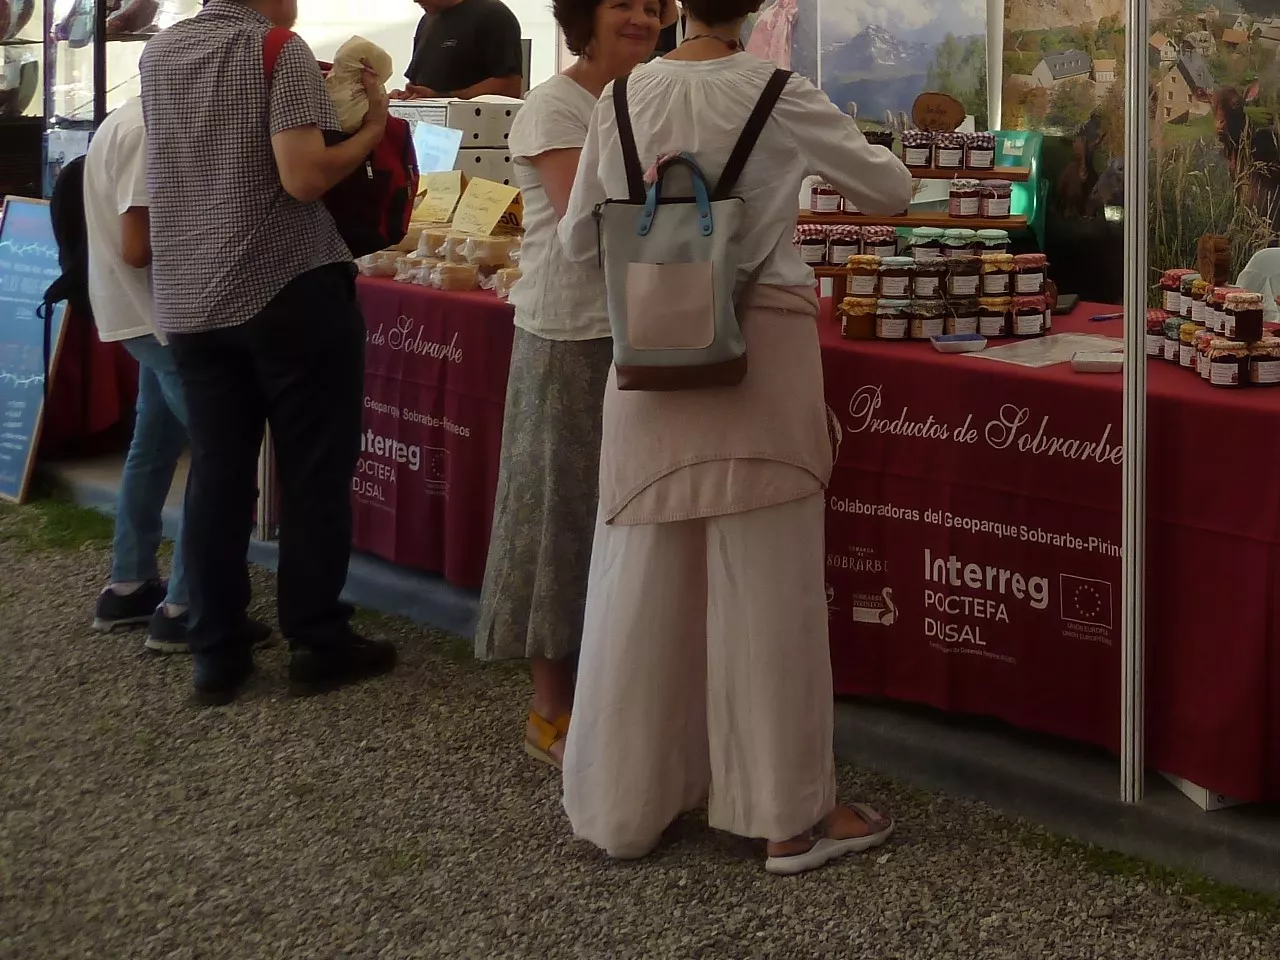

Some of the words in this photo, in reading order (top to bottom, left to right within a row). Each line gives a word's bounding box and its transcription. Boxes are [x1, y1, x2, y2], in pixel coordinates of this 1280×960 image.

[372, 323, 385, 345] de
[388, 315, 463, 364] Sobrarbe
[847, 384, 949, 440] Productos
[953, 414, 978, 444] de
[985, 403, 1123, 465] Sobrarbe
[830, 496, 919, 522] Colaboradoras
[924, 508, 942, 525] del
[944, 512, 1018, 538] Geoparque
[924, 548, 1049, 609] Interreg
[924, 590, 1009, 623] POCTEFA
[924, 618, 987, 646] DUSAL
